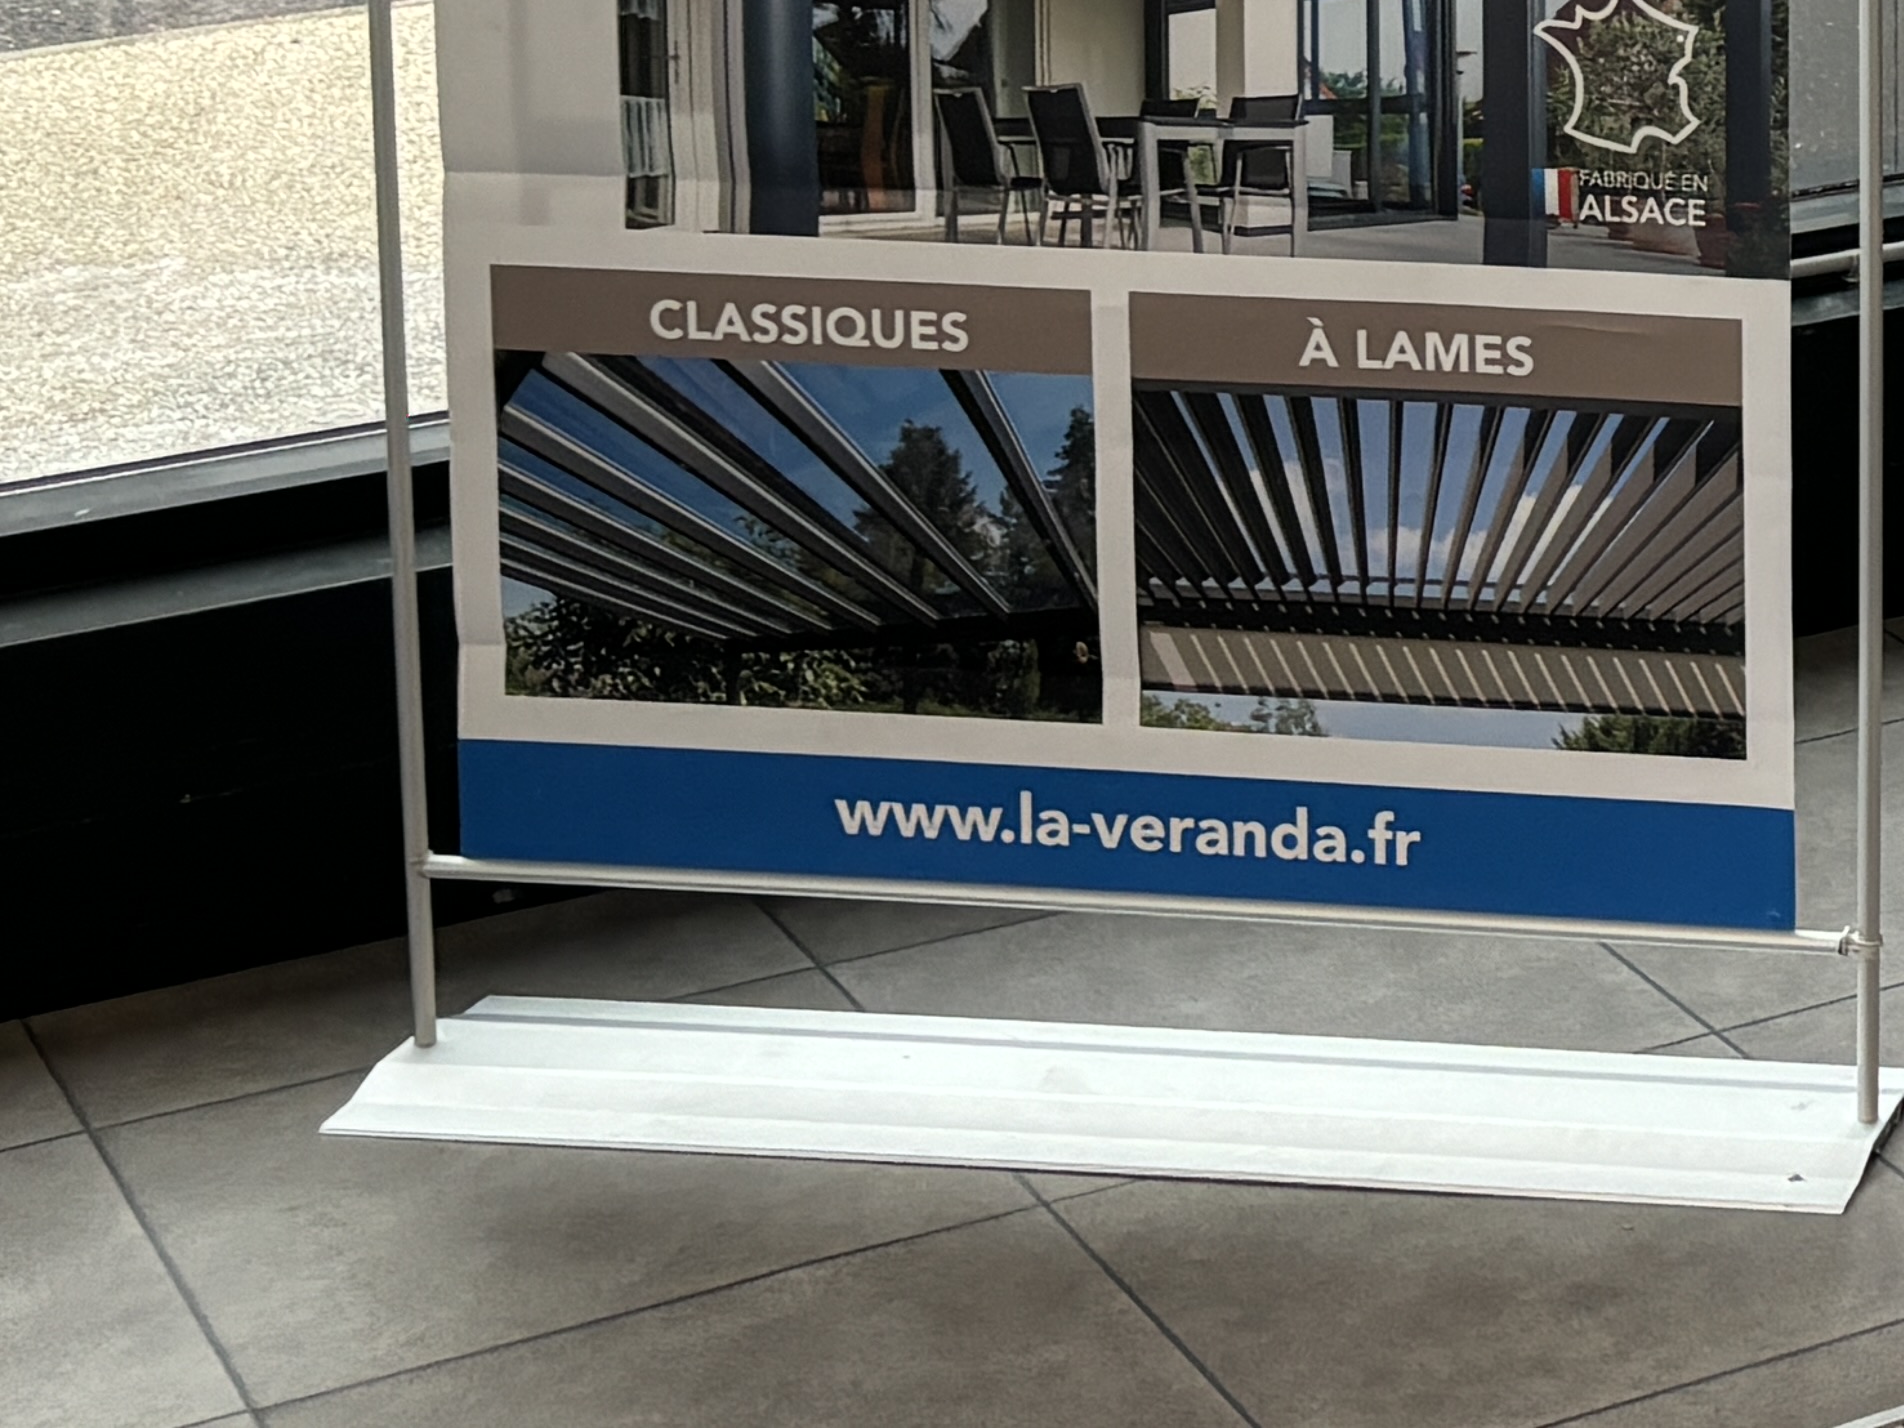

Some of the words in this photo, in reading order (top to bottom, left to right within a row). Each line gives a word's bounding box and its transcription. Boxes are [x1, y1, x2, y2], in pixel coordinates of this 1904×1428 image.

[1579, 168, 1676, 191] FABRIQUÉ
[1682, 173, 1709, 192] EN
[1579, 194, 1707, 227] ALSACE
[648, 298, 970, 355] CLASSIQUES
[1298, 317, 1340, 369] À
[1354, 328, 1536, 379] LAMES
[833, 788, 1422, 870] www.la-veranda.fr
